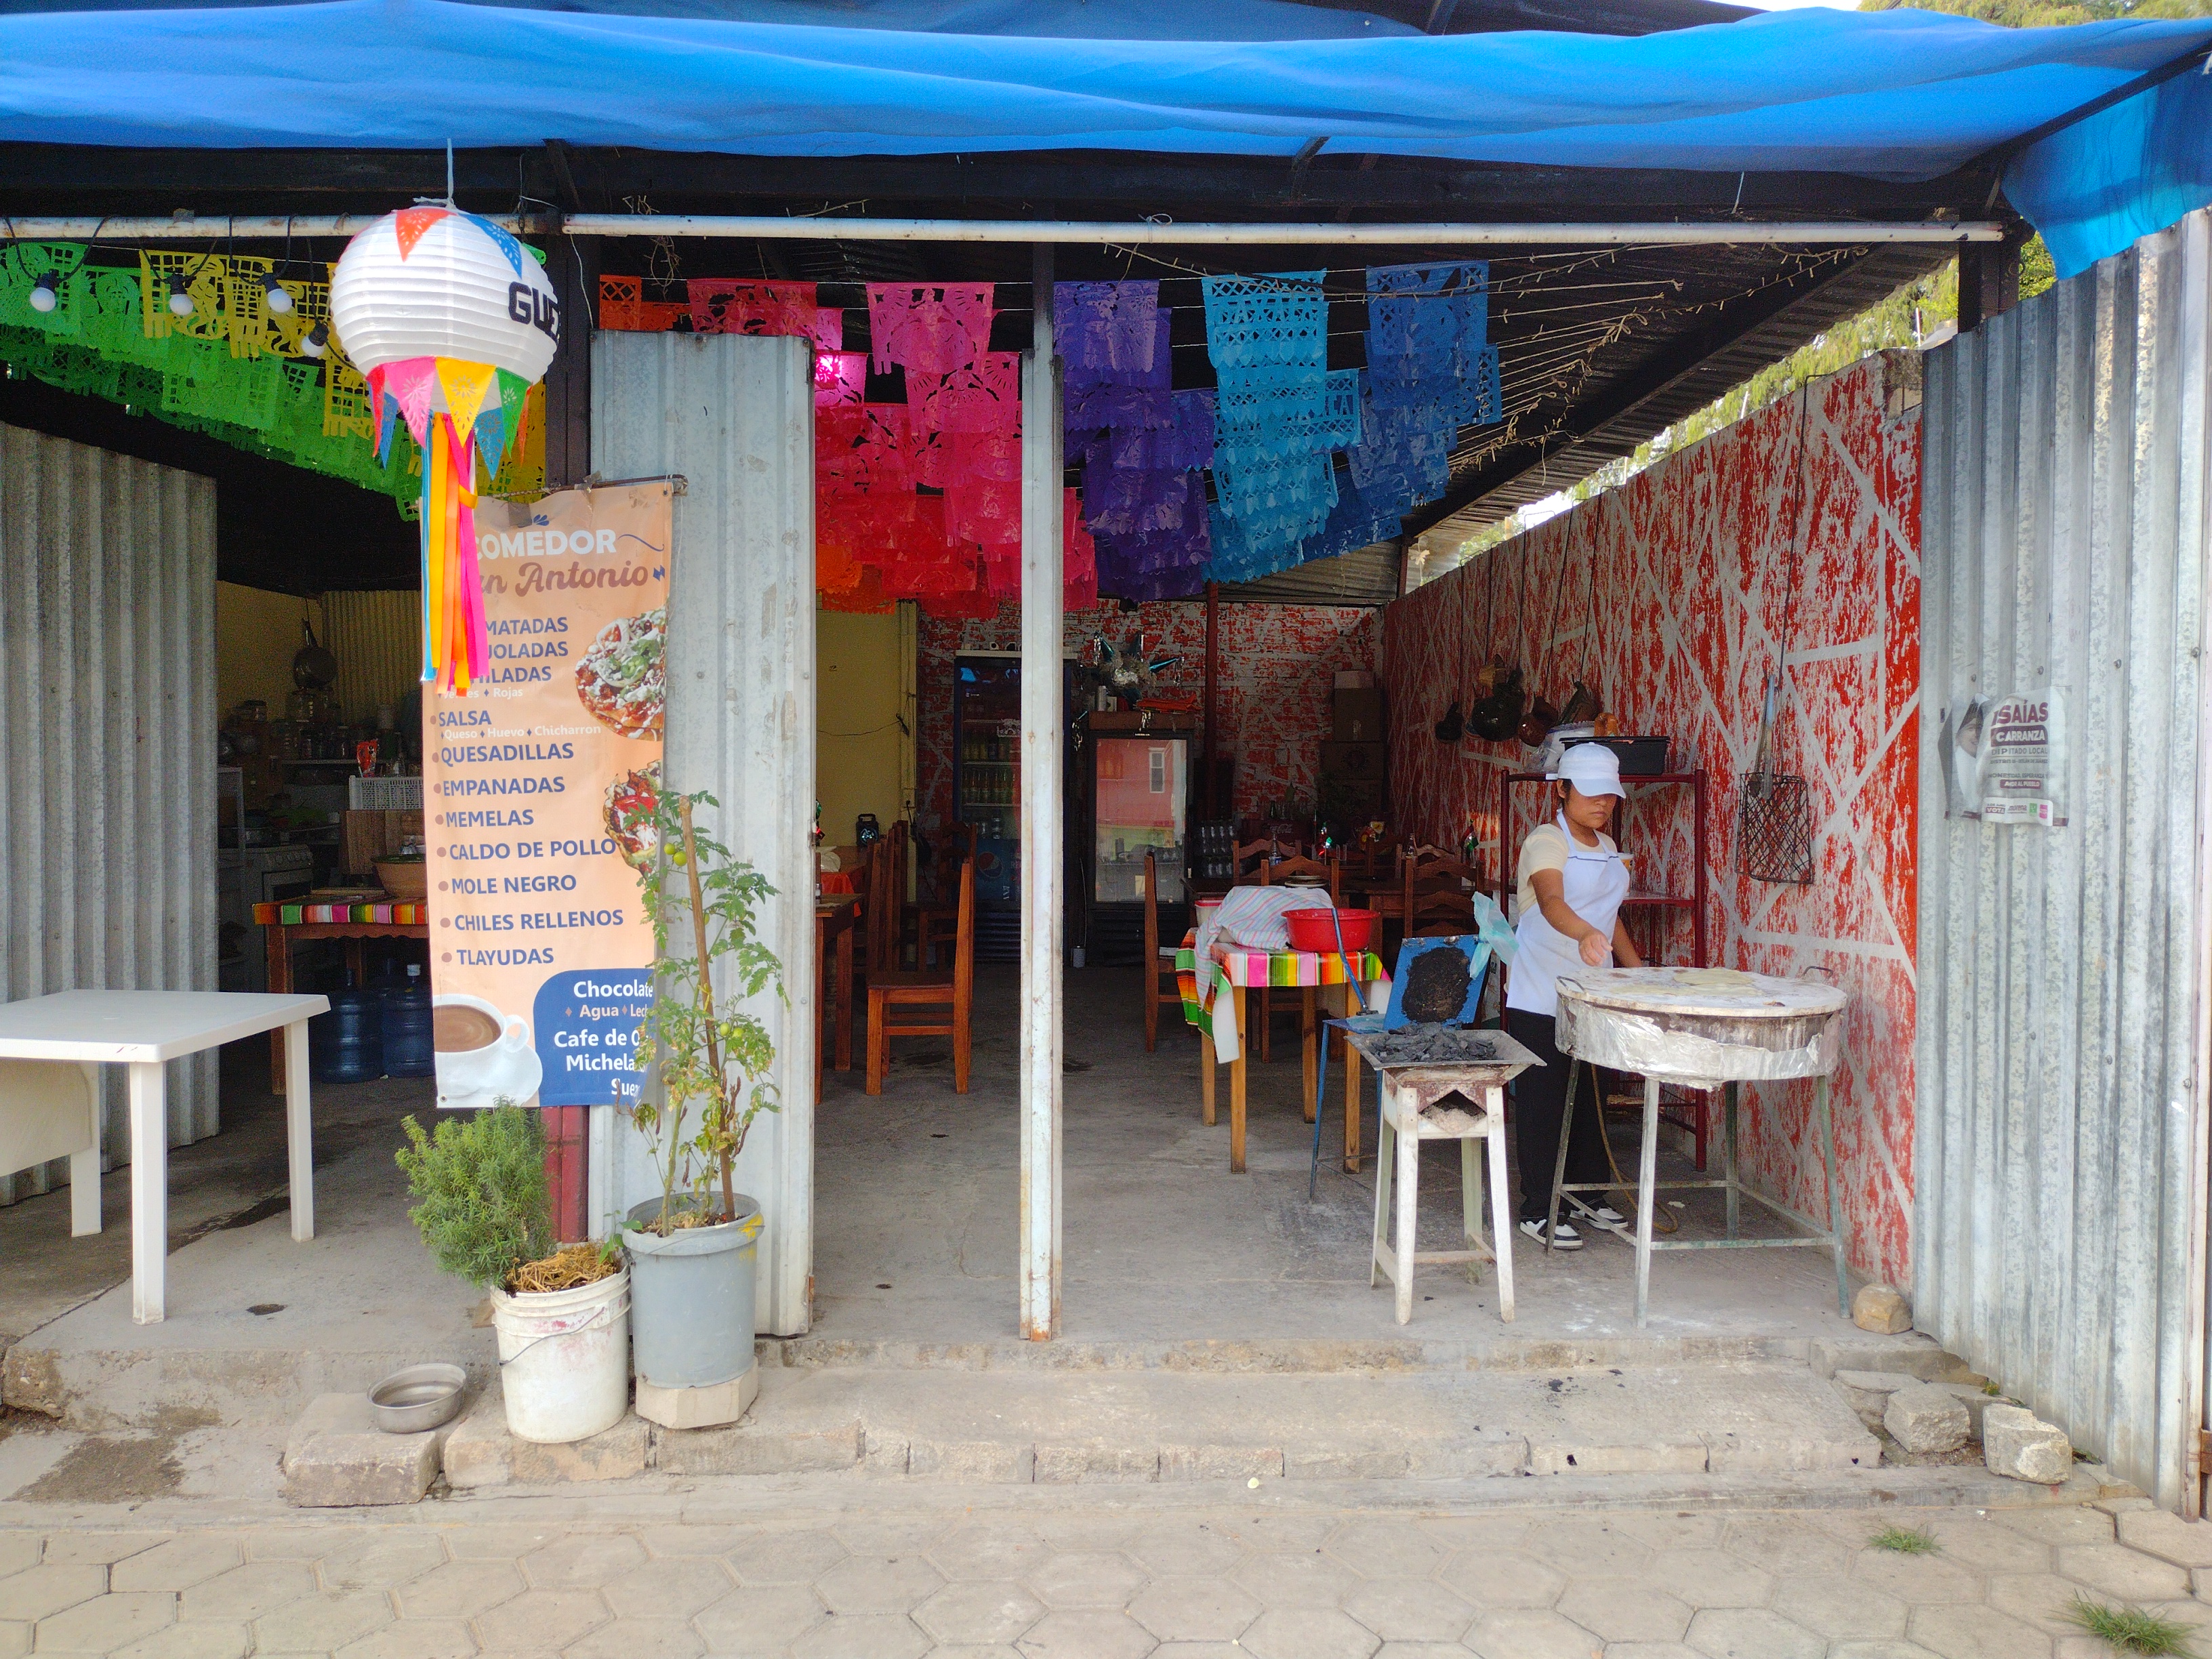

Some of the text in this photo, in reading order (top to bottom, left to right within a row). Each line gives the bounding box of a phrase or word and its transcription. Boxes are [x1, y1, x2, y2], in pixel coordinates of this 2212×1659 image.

[515, 560, 649, 597] Antonio
[485, 617, 569, 635] MATADAS
[488, 641, 569, 659] JOLADAS
[471, 666, 552, 684] LADAS
[493, 687, 523, 699] Rojas
[439, 710, 492, 726] SALSA
[1991, 699, 2048, 726] ISAÍAS
[445, 725, 601, 741] Queso Huevo Chicharron
[1996, 730, 2045, 742] CARRANZA
[441, 743, 574, 767] QUESADILLAS
[443, 777, 565, 796] EMPANADAS
[446, 809, 534, 827] MEMELAS
[449, 838, 616, 860] CALDO DE POLLO
[451, 875, 577, 895] MOLE NEGRO
[455, 909, 623, 931] CHILES RELLENOS
[457, 948, 554, 965] TLAYUDAS
[573, 979, 653, 998] Chocolate
[579, 1004, 619, 1021] Agua
[554, 1029, 599, 1048] Cafe
[605, 1028, 628, 1046] de
[566, 1053, 646, 1072] Michela
